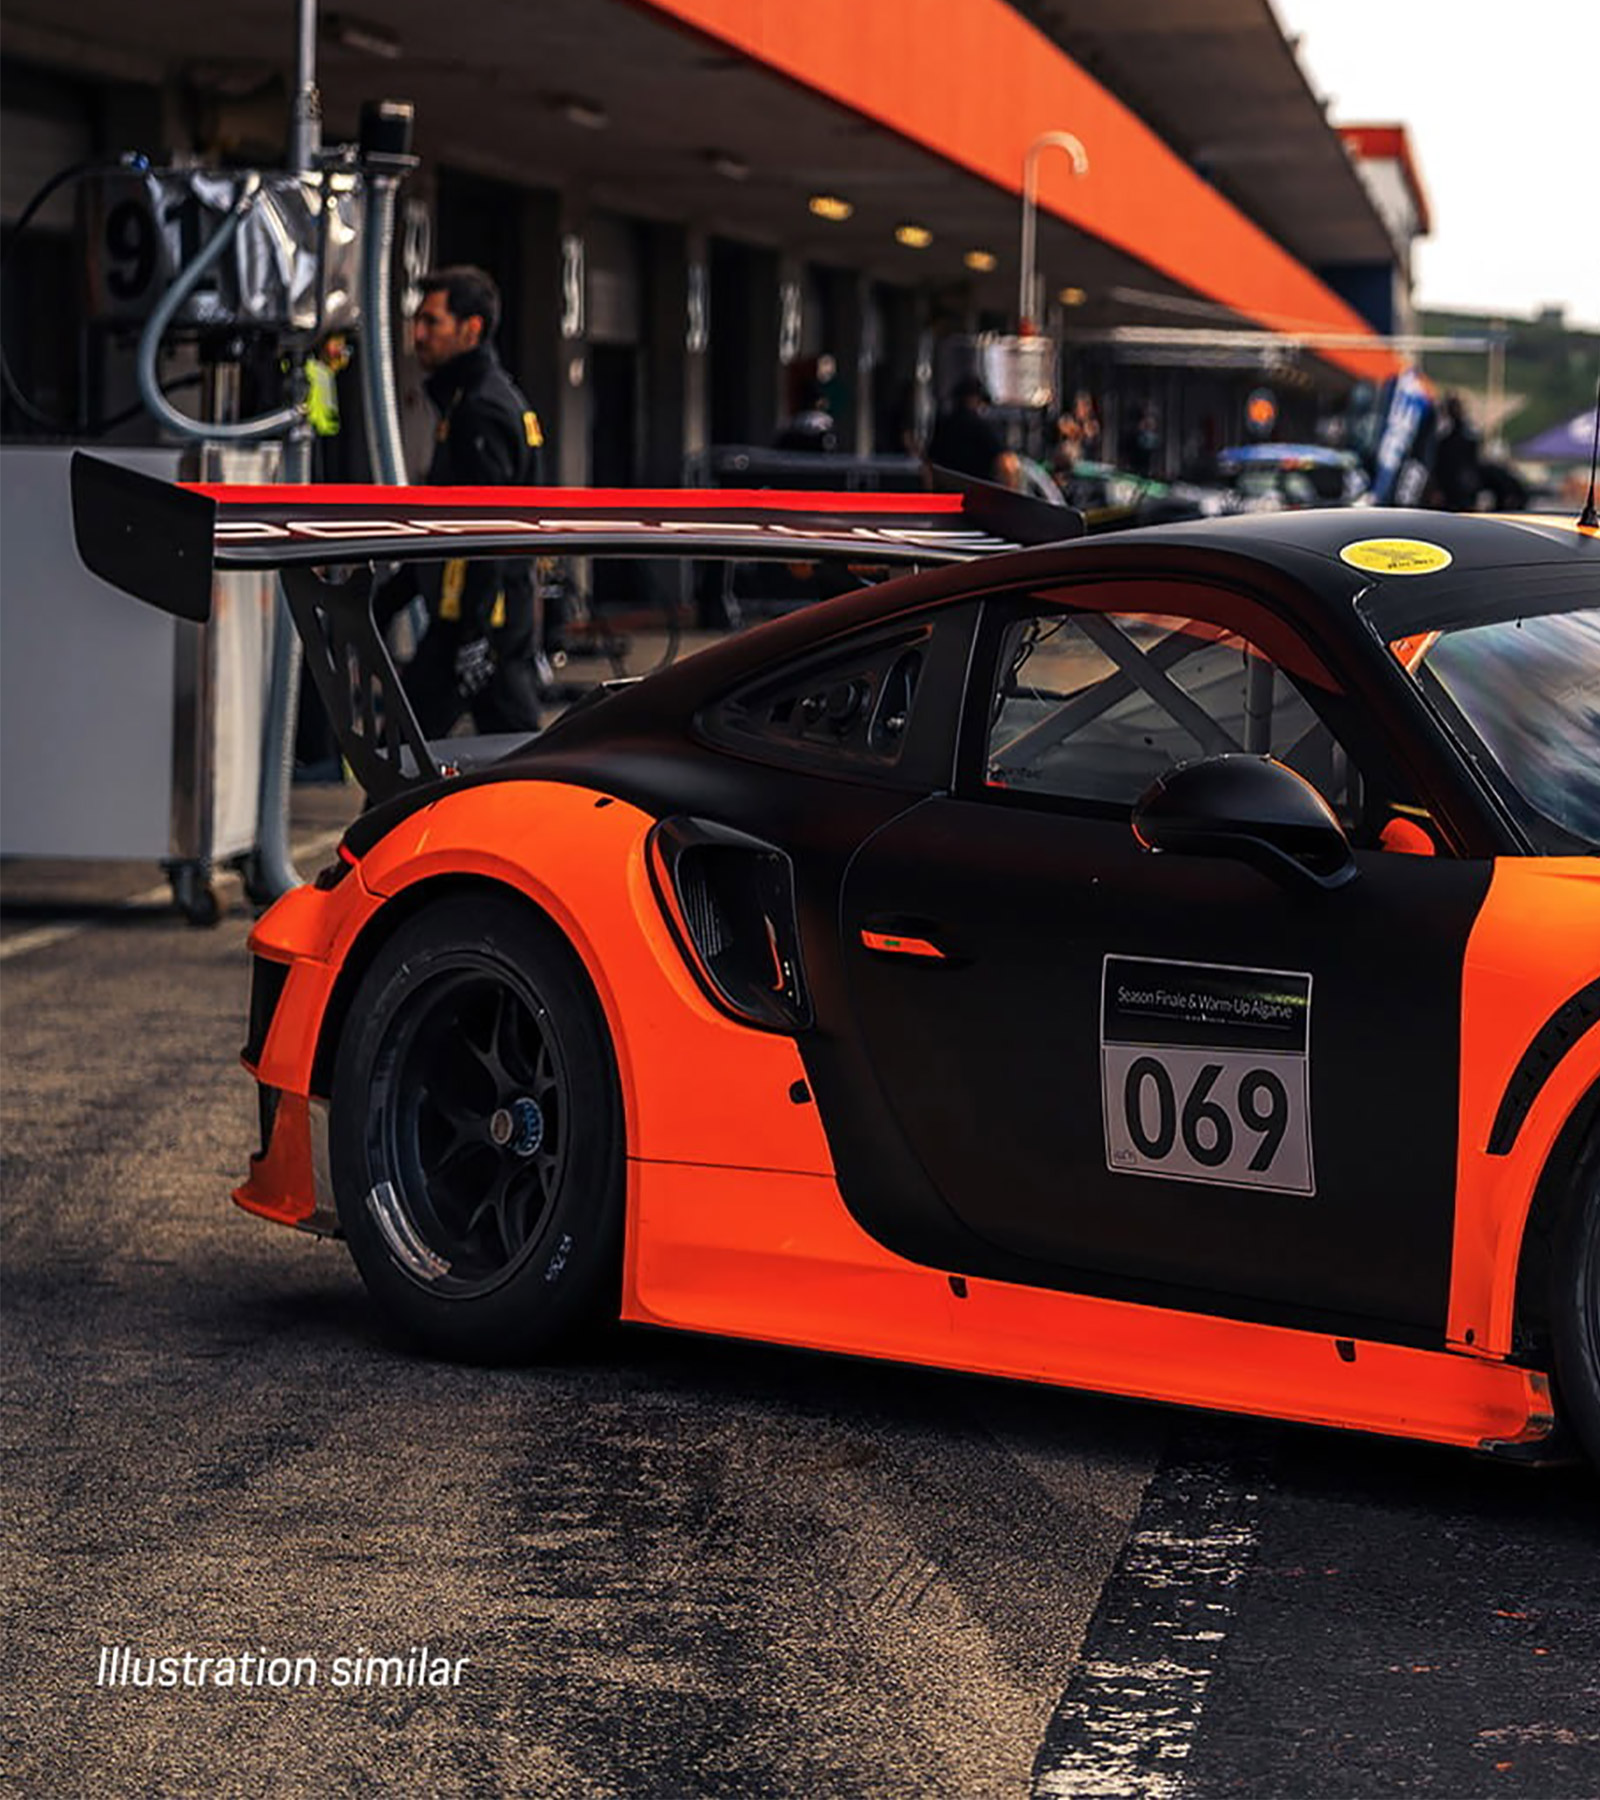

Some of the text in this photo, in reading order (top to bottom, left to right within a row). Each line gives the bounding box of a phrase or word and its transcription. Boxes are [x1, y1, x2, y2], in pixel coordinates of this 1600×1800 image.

[1117, 985, 1293, 1019] Season Finale & Warm-Up Algarve
[1124, 1055, 1289, 1172] 069
